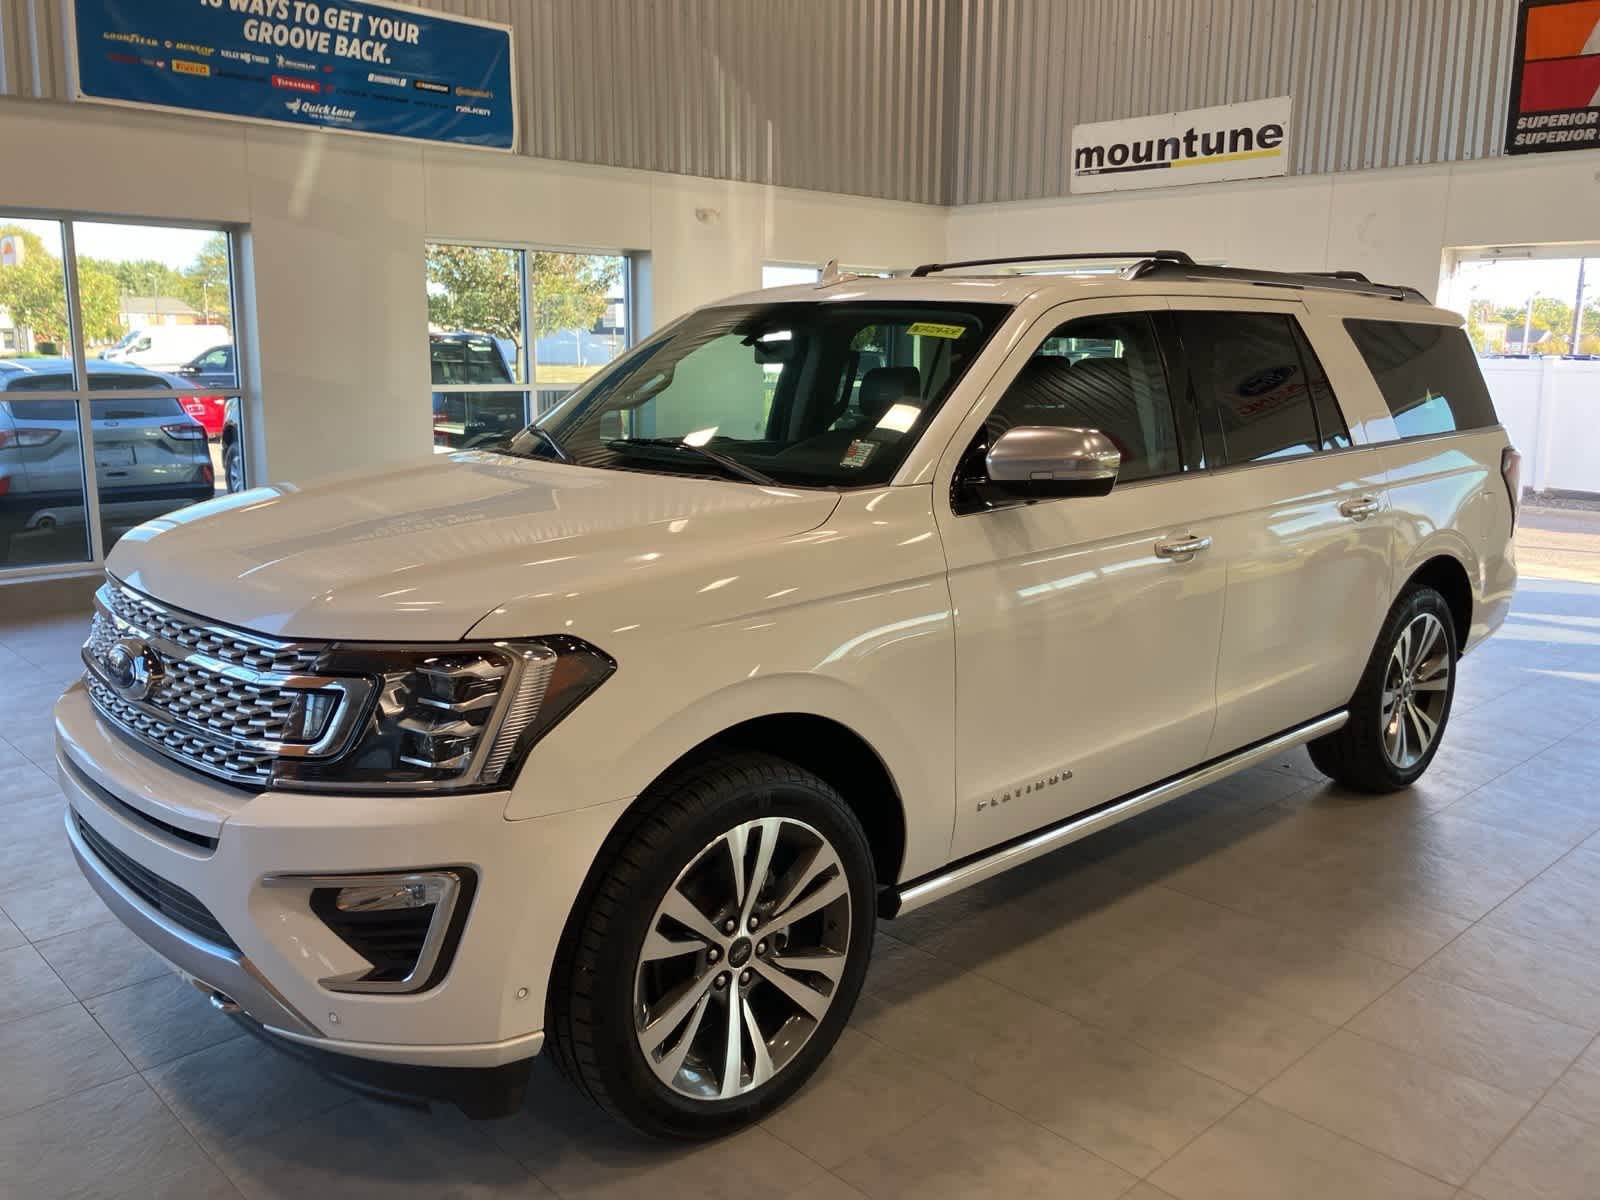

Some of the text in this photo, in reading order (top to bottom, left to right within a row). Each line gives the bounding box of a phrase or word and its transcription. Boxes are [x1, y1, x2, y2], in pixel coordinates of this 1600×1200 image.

[243, 18, 392, 65] GROOVE BACK.
[294, 1, 320, 26] TO
[324, 8, 364, 34] GET
[368, 15, 420, 45] YOUR
[301, 101, 331, 115] Quick
[331, 105, 357, 119] Lane
[1516, 111, 1599, 130] SUPERIOR
[1074, 123, 1284, 170] mountune
[1513, 128, 1597, 146] SUPERIOR
[976, 768, 1073, 812] PLATINUM
